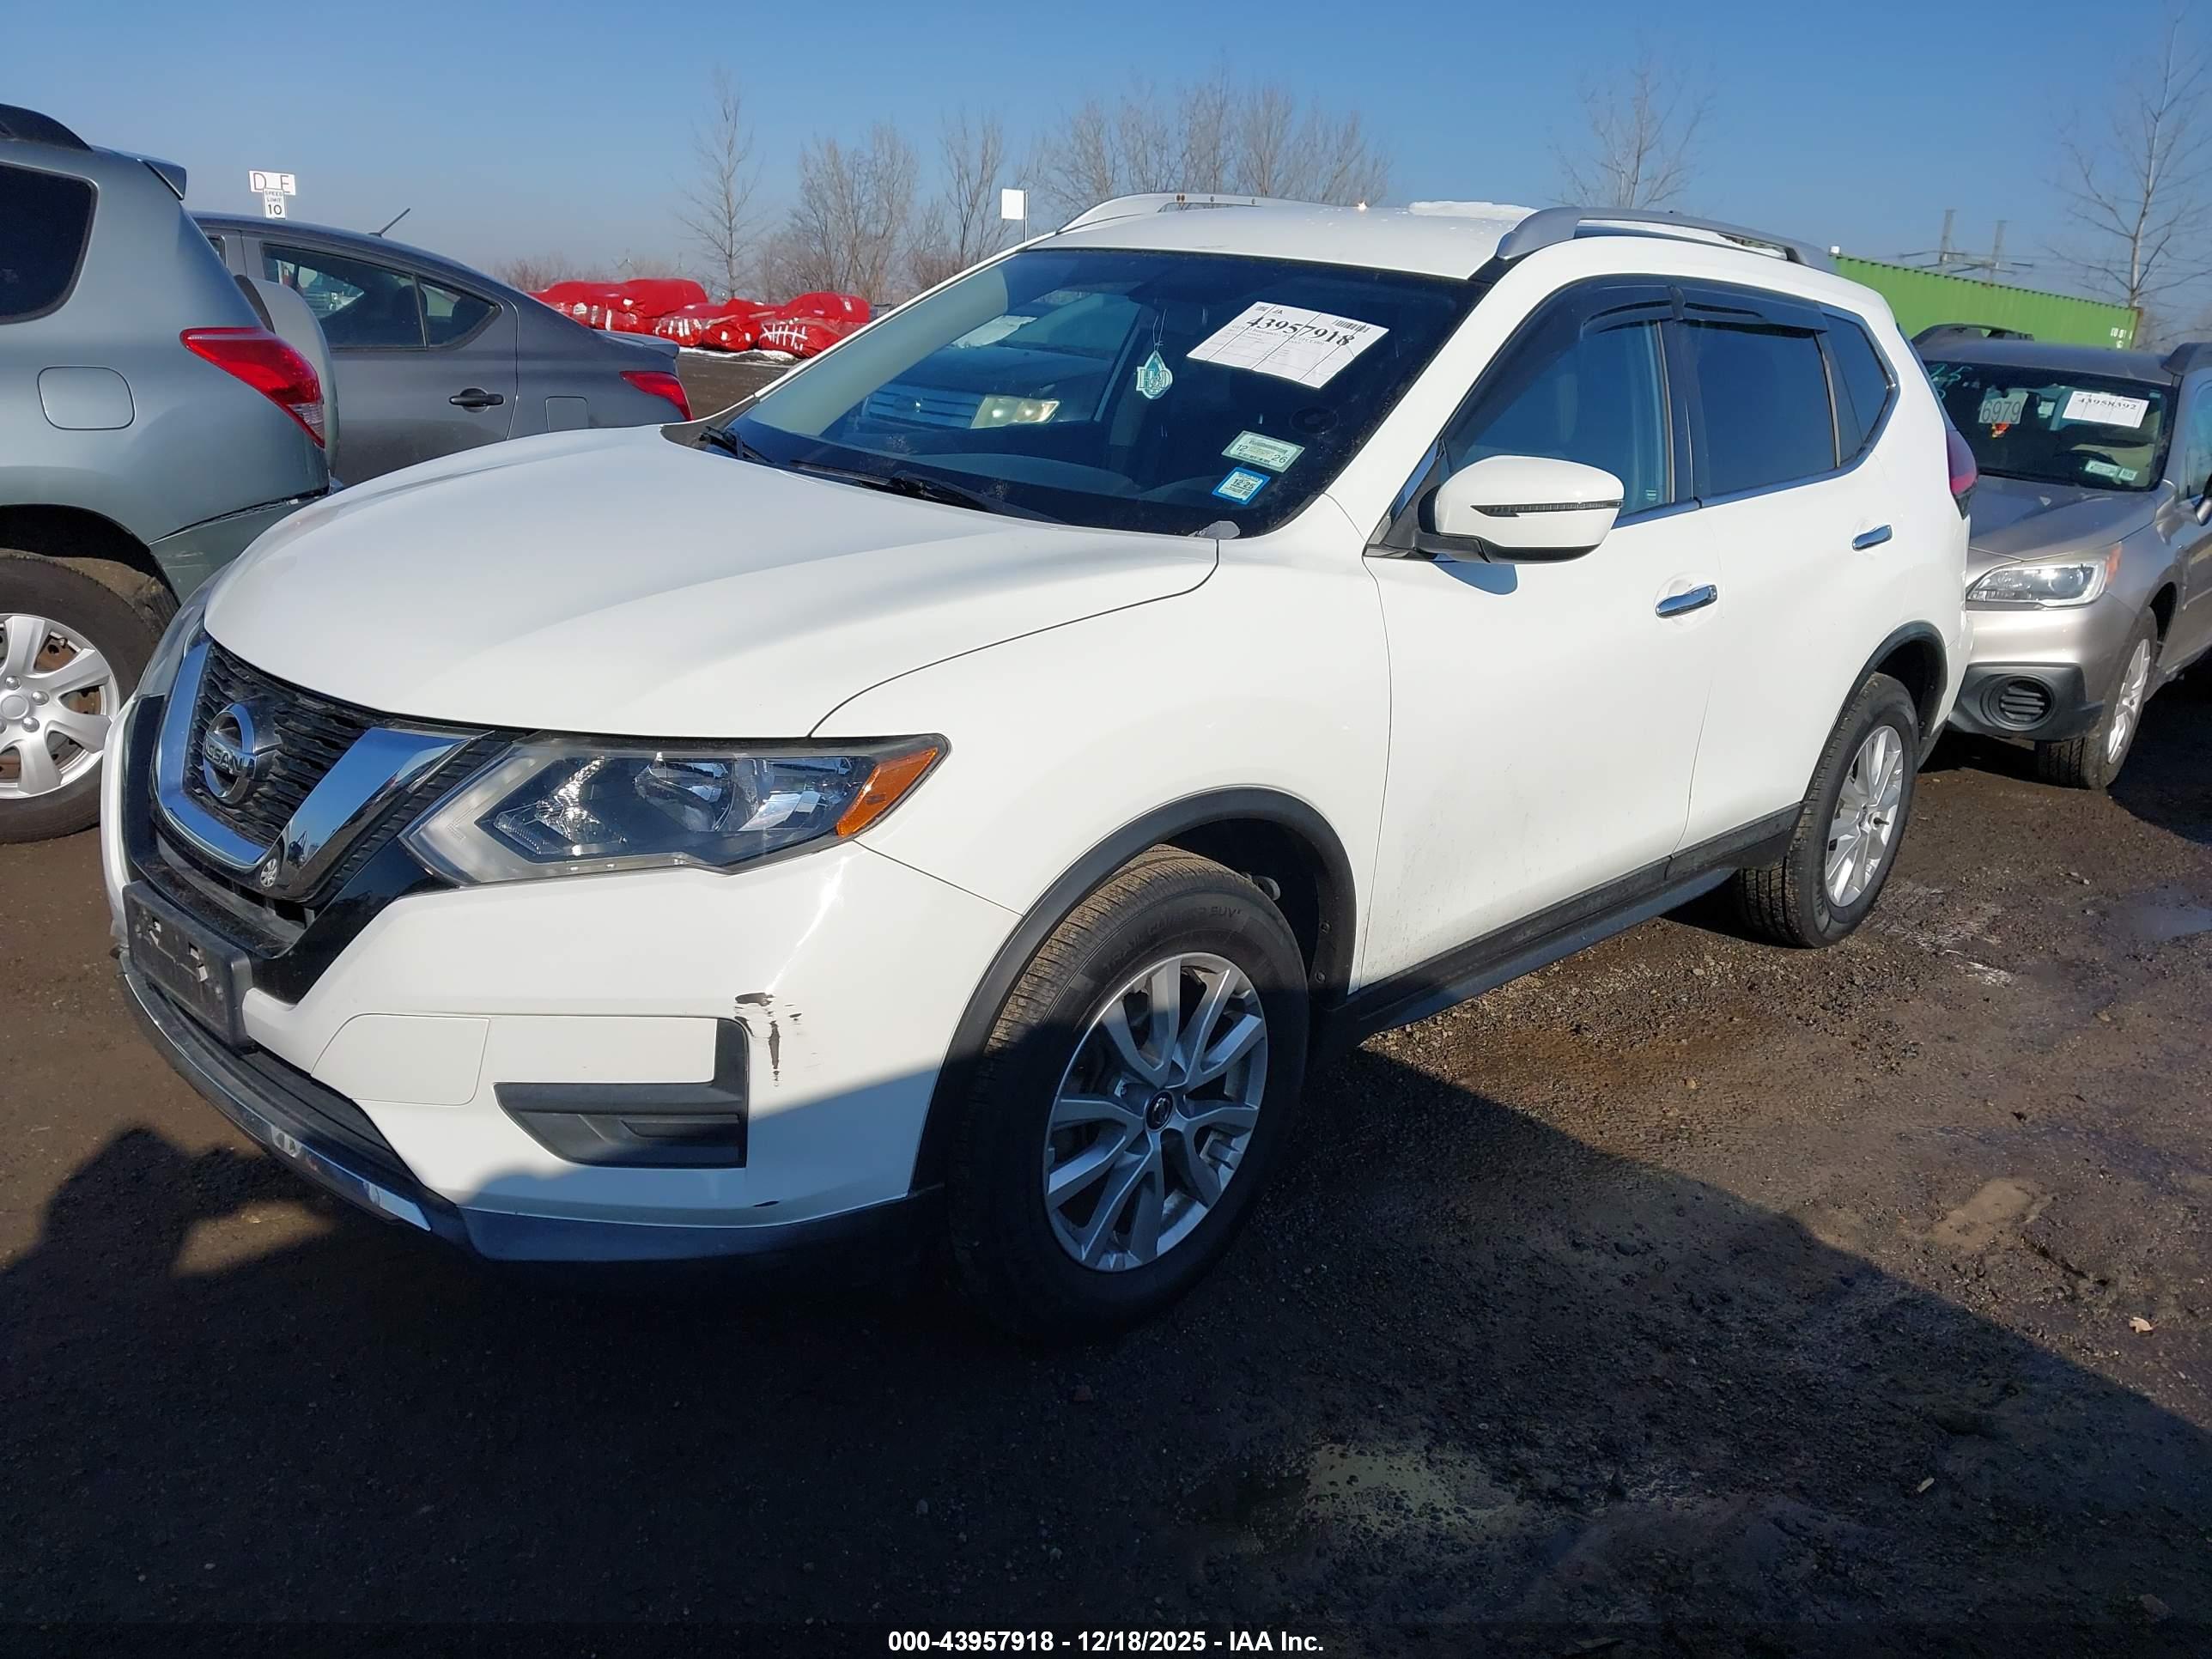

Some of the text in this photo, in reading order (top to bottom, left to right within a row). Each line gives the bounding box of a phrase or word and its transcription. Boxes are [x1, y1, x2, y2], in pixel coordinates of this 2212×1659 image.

[252, 173, 291, 193] D E
[268, 204, 283, 215] 10
[1246, 315, 1355, 346] 43957918
[1981, 400, 2021, 422] 6979
[1236, 444, 1249, 453] 12
[1271, 453, 1288, 464] 26
